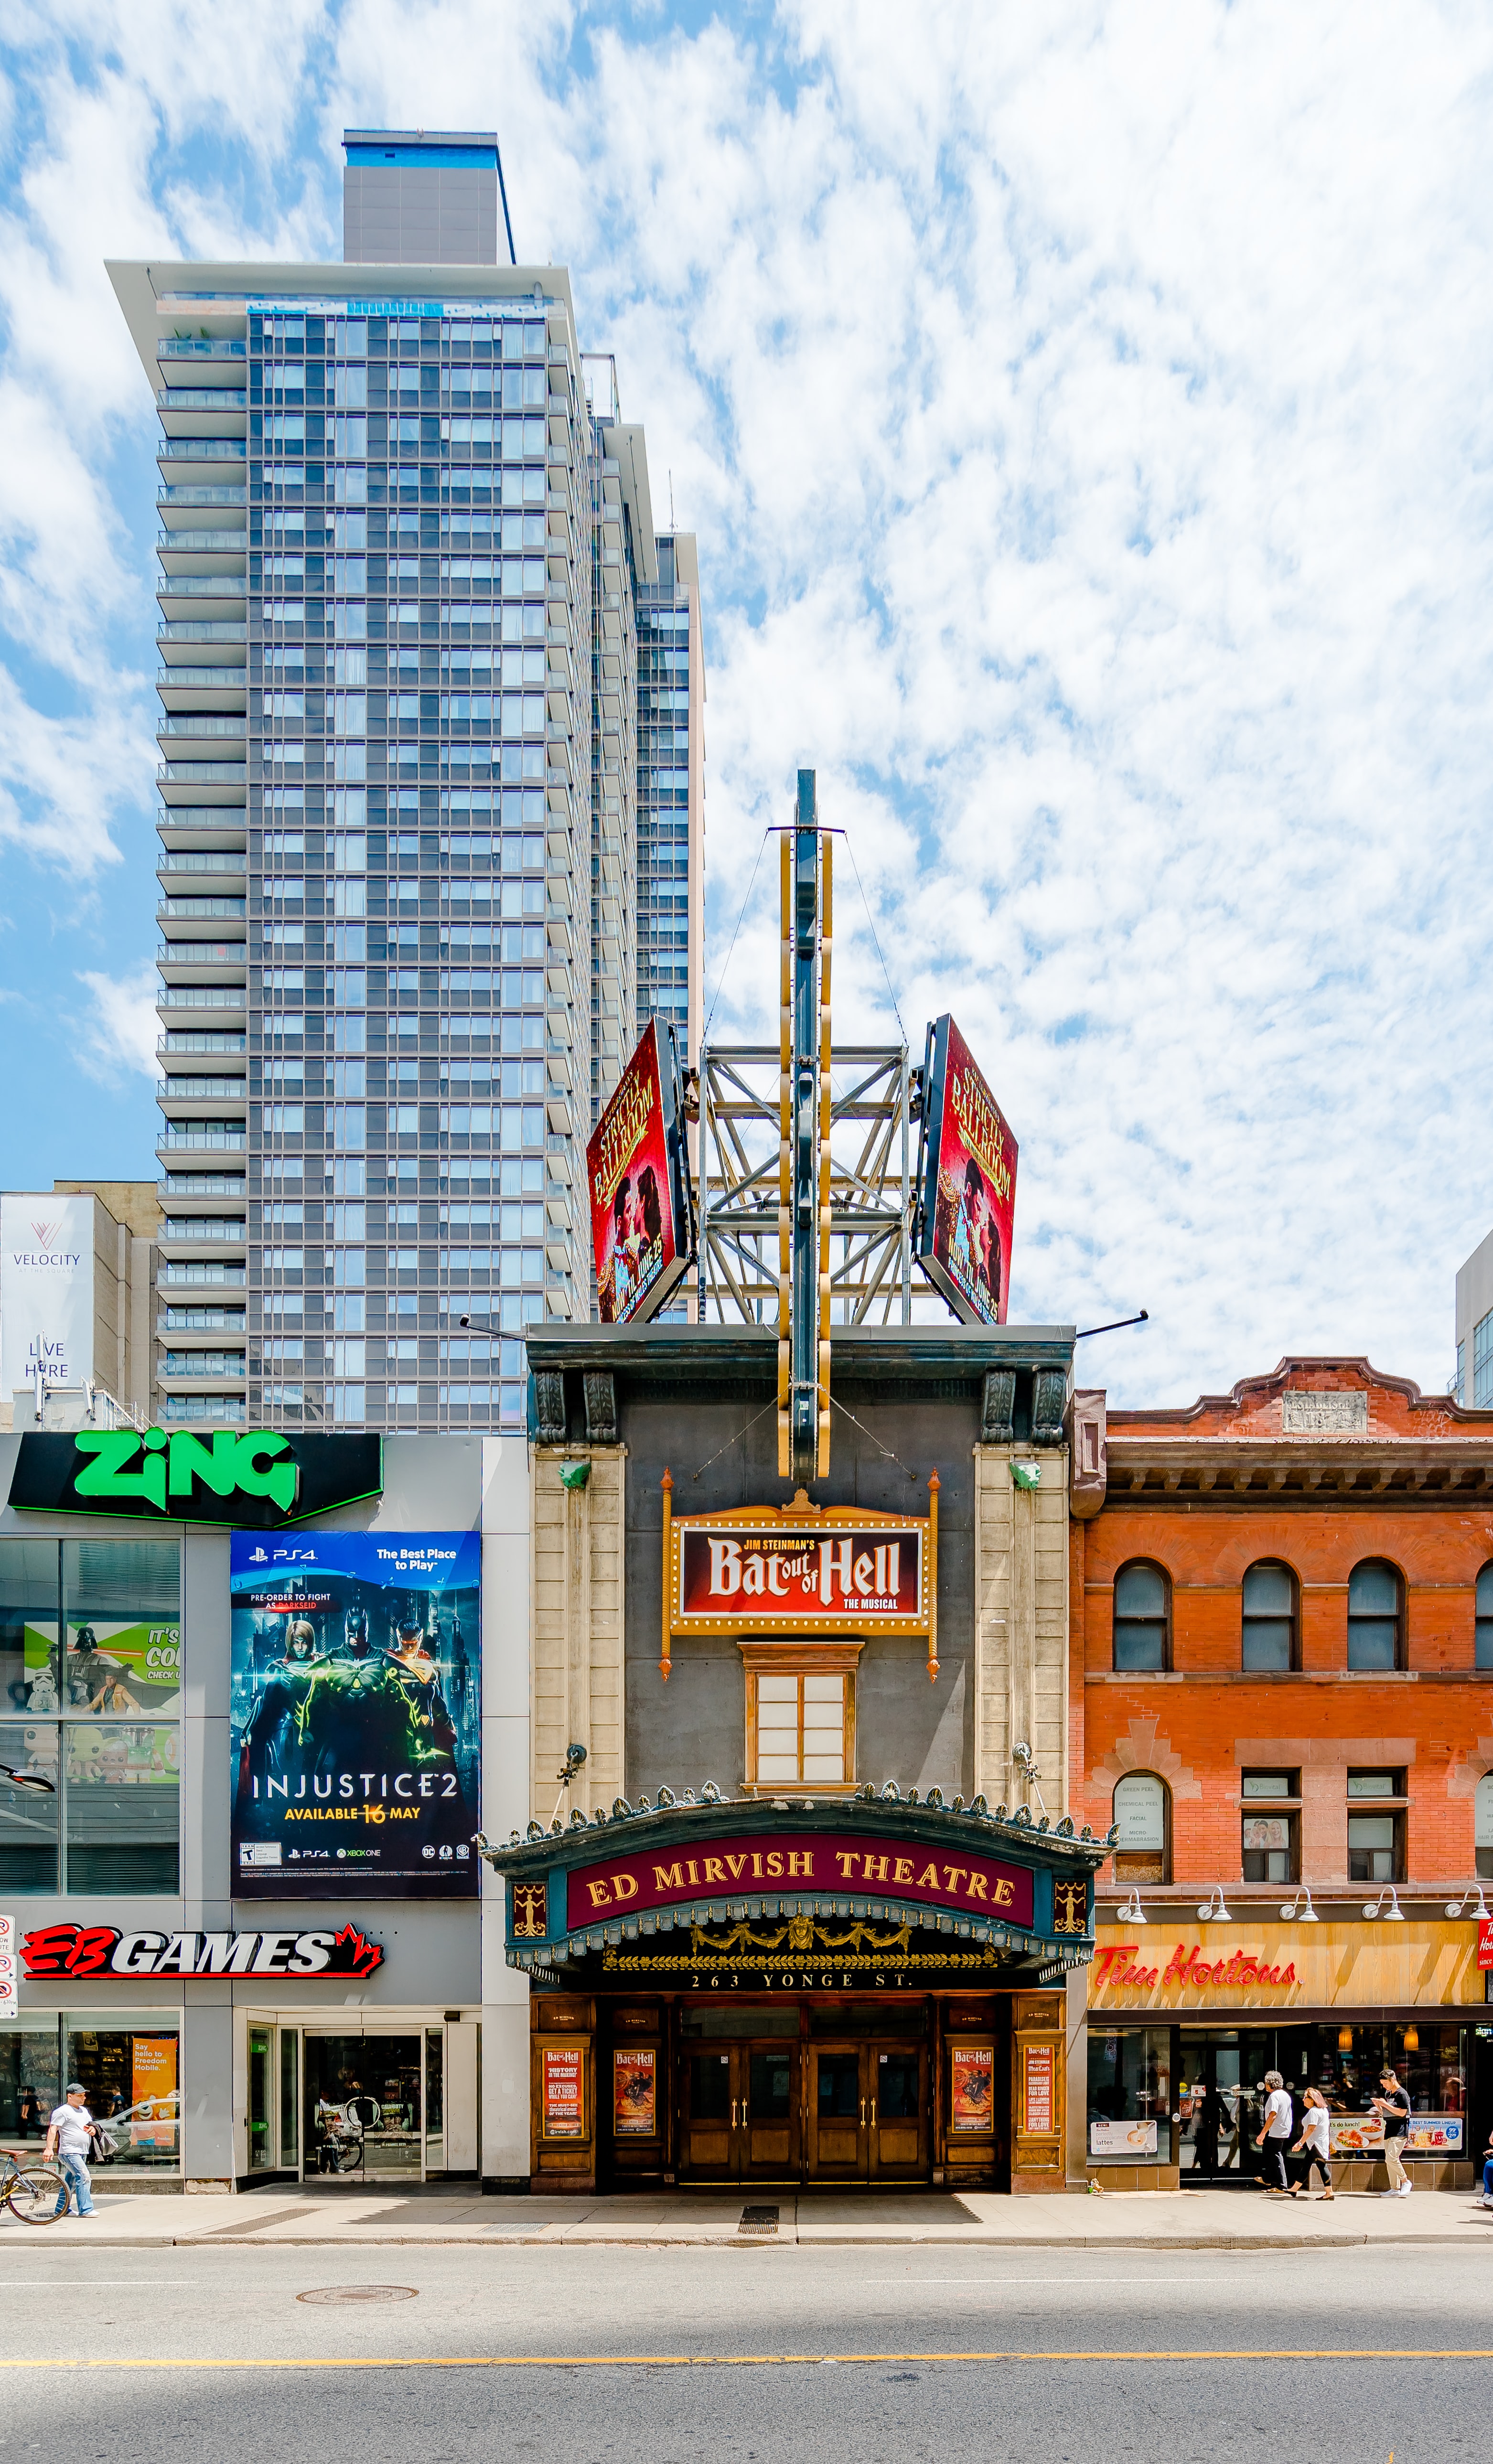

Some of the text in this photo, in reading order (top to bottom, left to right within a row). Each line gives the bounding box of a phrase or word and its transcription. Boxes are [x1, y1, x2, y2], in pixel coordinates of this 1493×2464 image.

[601, 1069, 640, 1163] STRICTLY
[963, 1066, 1004, 1157] STRICTLY
[595, 1075, 654, 1205] BALLROOM
[951, 1071, 1011, 1202] BALLROOM
[14, 1254, 80, 1265] VELOCITY
[612, 1232, 662, 1322] NOW JUNE 25
[635, 1278, 647, 1304] WALES
[647, 1255, 663, 1286] THEATRE
[948, 1233, 998, 1321] NOW JUNE 25
[30, 1343, 64, 1356] LVE
[25, 1364, 68, 1377] HRE
[273, 1549, 456, 1560] PS4 The Best Place
[744, 1540, 815, 1551] JIM STEINMAN'S
[395, 1561, 407, 1570] to
[708, 1537, 901, 1607] Bat out of Hell
[844, 1598, 898, 1610] THE MUSICAL
[148, 1627, 180, 1644] IT'S
[147, 1671, 175, 1679] CHECK
[253, 1774, 457, 1798] INJUSTICE 2
[285, 1804, 420, 1823] AVAILABLE 16 MAY
[586, 1851, 1015, 1907] ED MIRVISH THEATRE
[20, 1923, 336, 1977] EB GAMES
[1094, 1944, 1296, 1987] Tim Hortons
[692, 1974, 912, 1987] 263 YONGE ST.
[547, 2052, 578, 2063] Bat Hell
[616, 2053, 653, 2066] Bat Hell
[955, 2051, 991, 2064] Bat Hell
